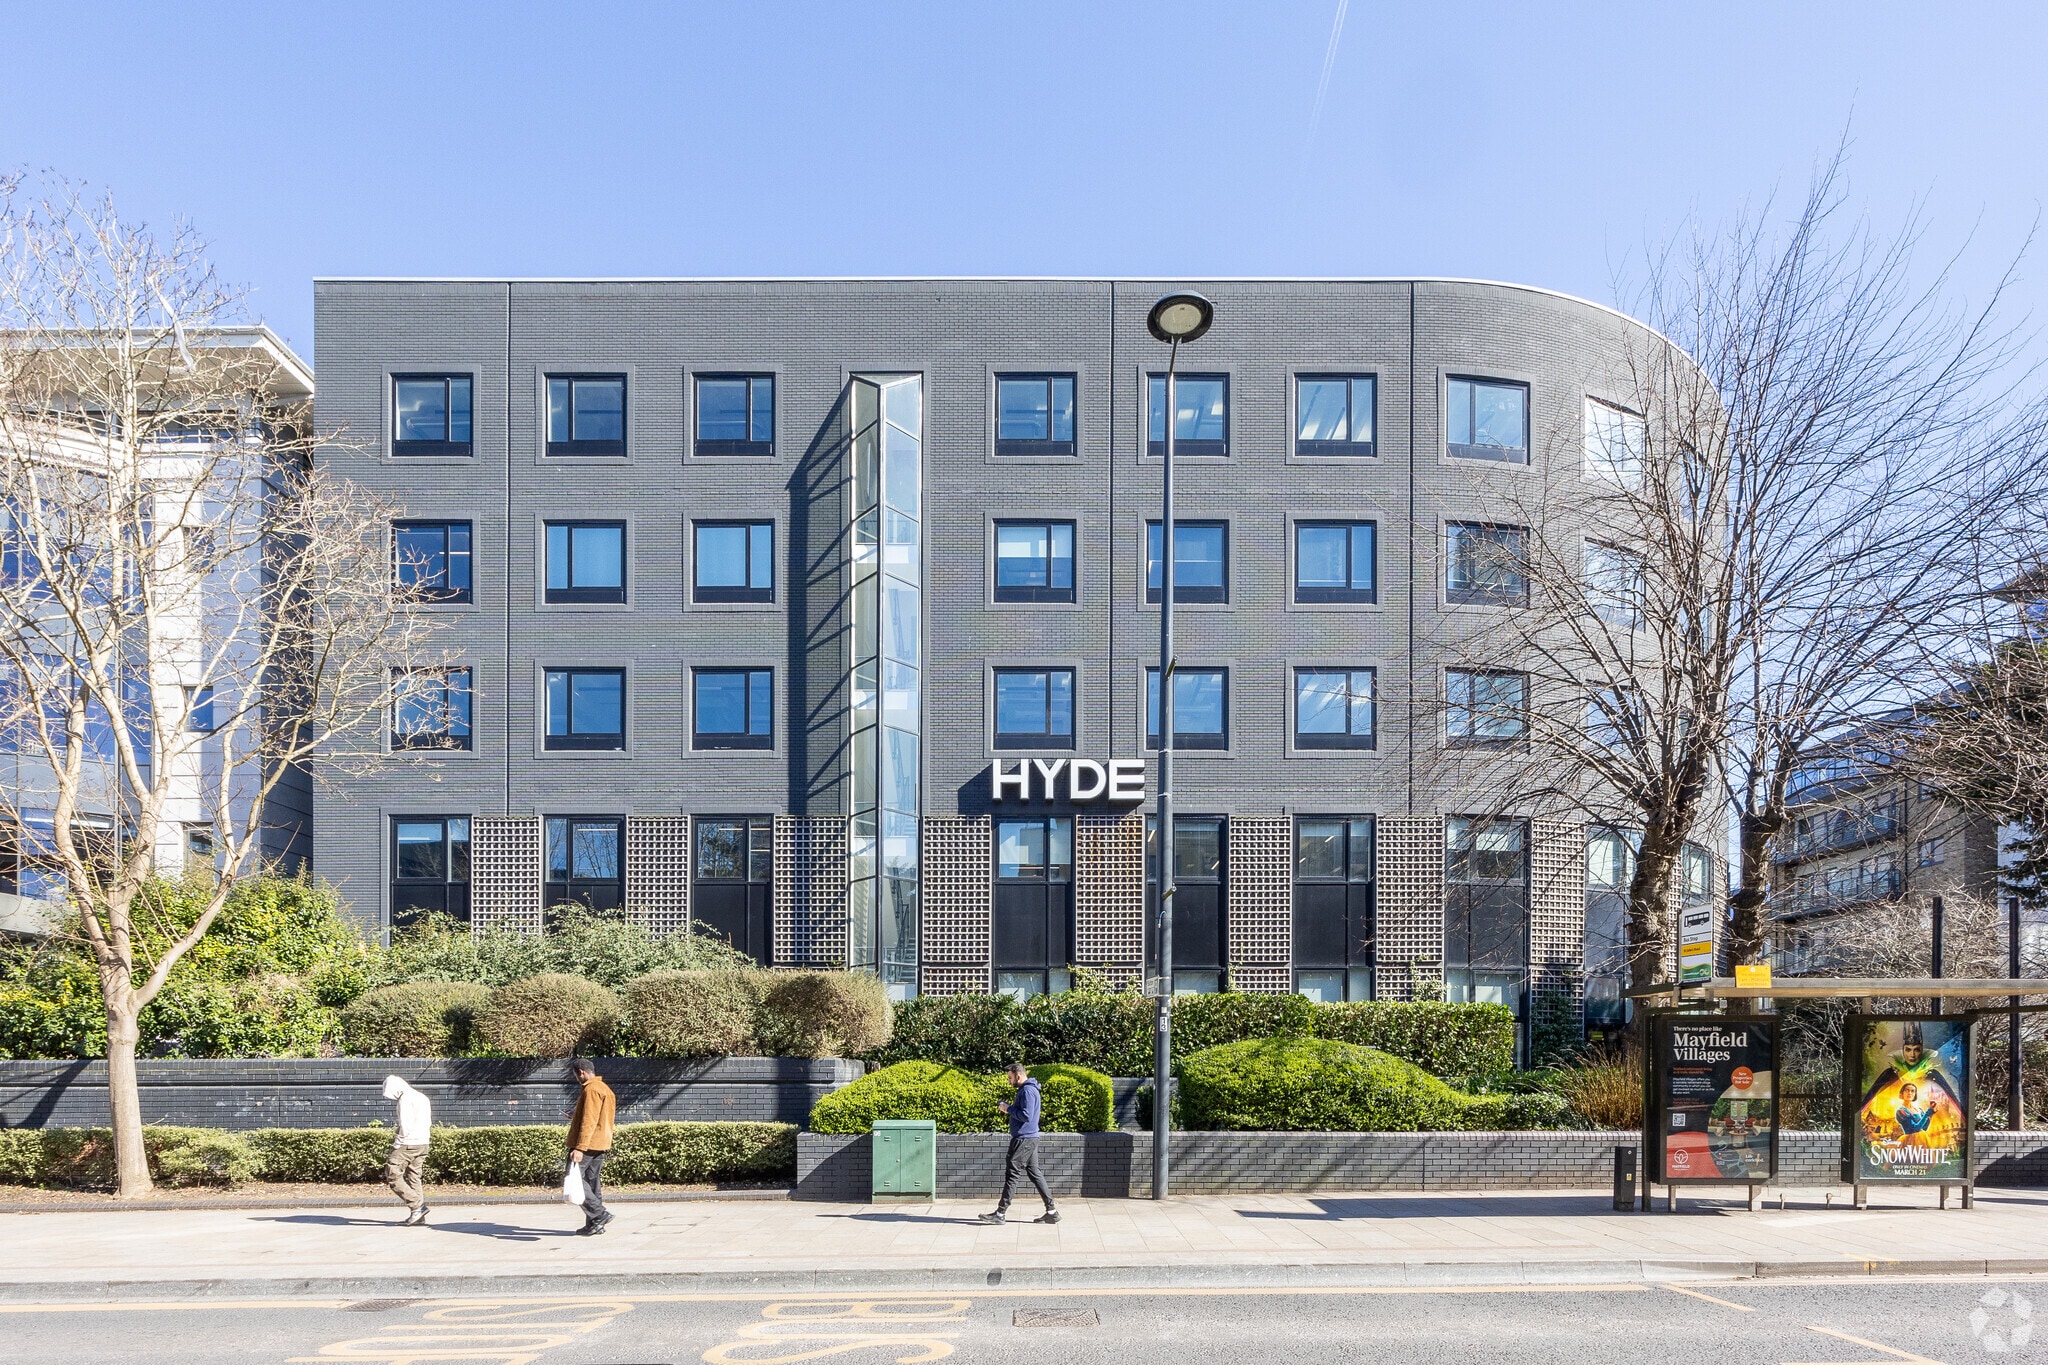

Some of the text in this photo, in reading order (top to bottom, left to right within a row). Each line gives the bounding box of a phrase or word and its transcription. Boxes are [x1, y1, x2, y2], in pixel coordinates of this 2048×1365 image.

[992, 758, 1146, 801] HYDE
[1673, 1032, 1748, 1050] Mayfield
[1673, 1048, 1730, 1064] Villages
[1880, 1138, 1902, 1147] Disney
[283, 1302, 635, 1365] STO
